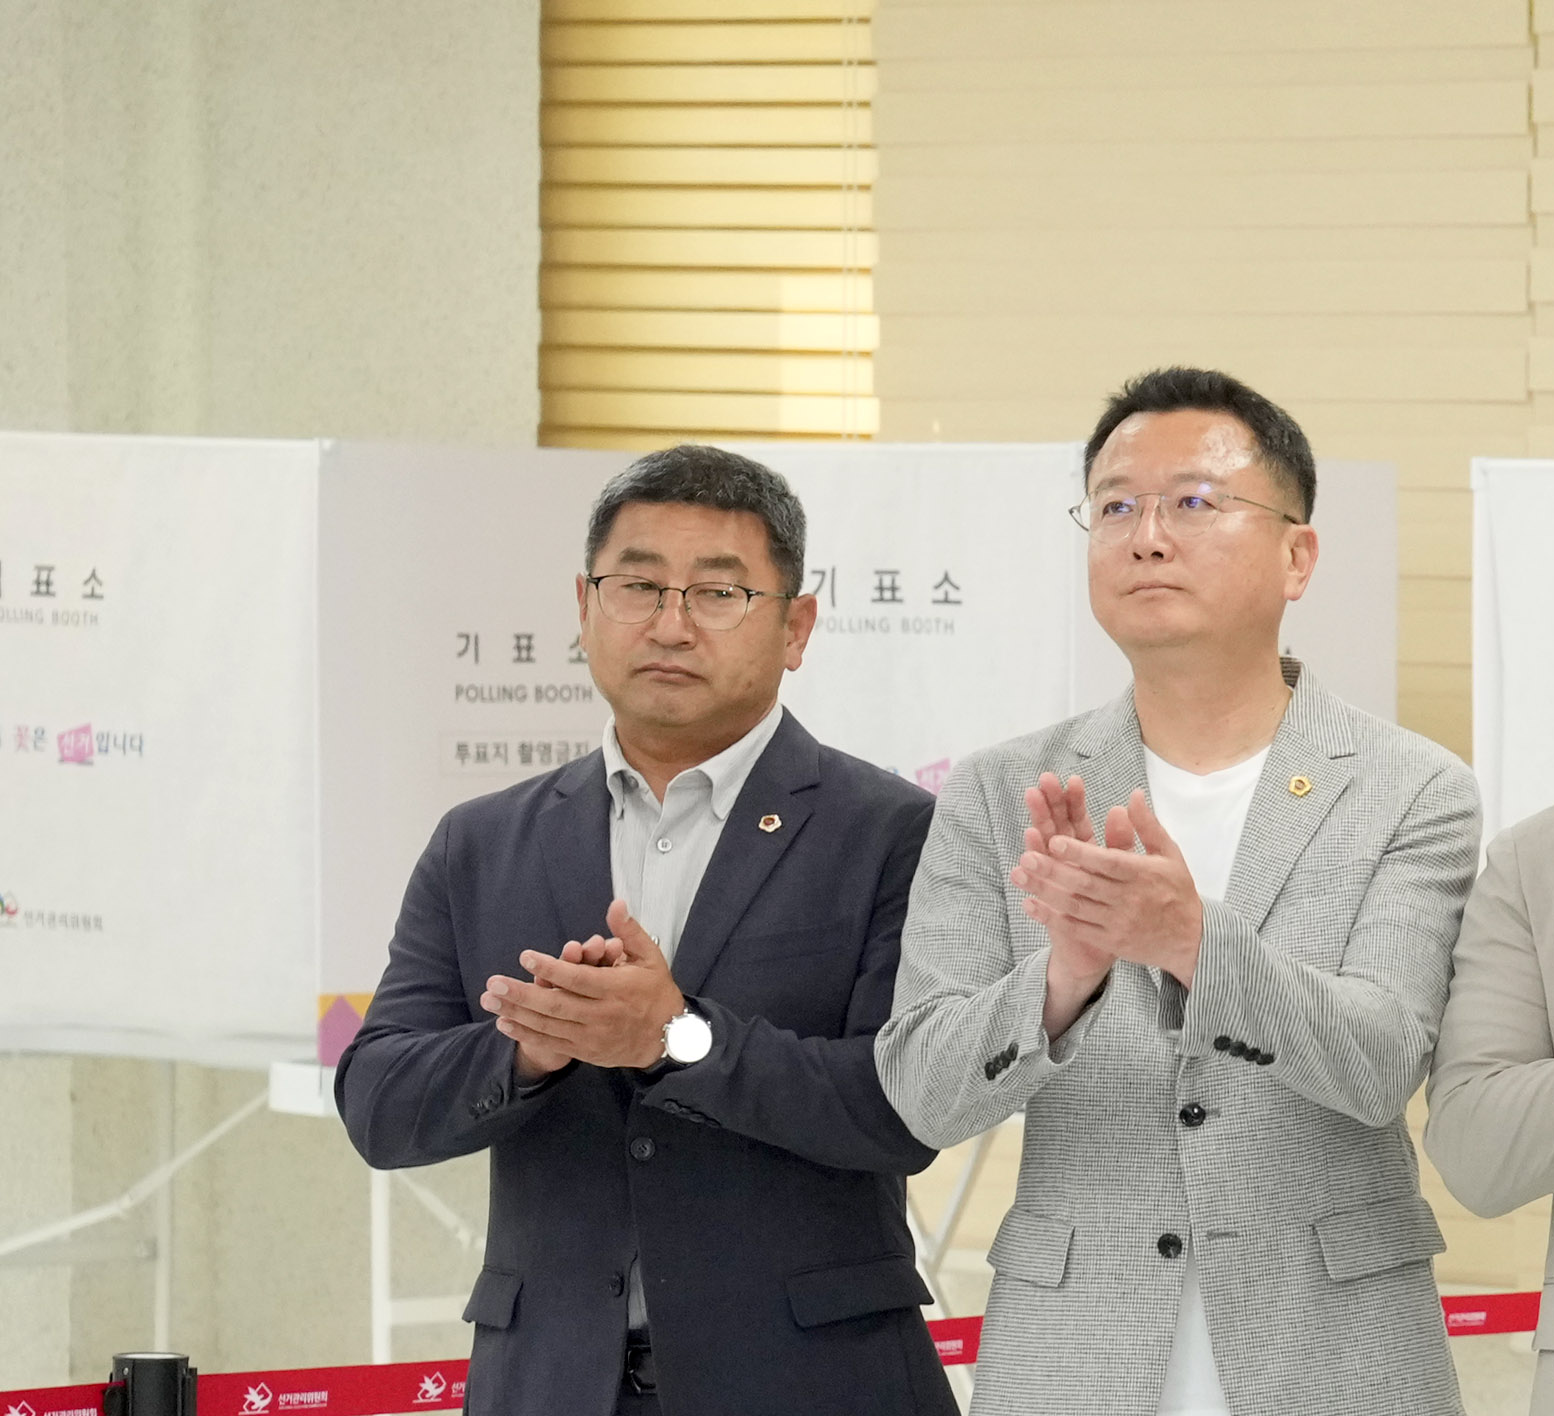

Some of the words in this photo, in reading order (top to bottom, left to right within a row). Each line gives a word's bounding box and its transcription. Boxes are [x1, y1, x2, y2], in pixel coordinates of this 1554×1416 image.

[455, 684, 528, 703] POLLING
[534, 684, 593, 703] BOOTH
[455, 742, 508, 766] 투표지
